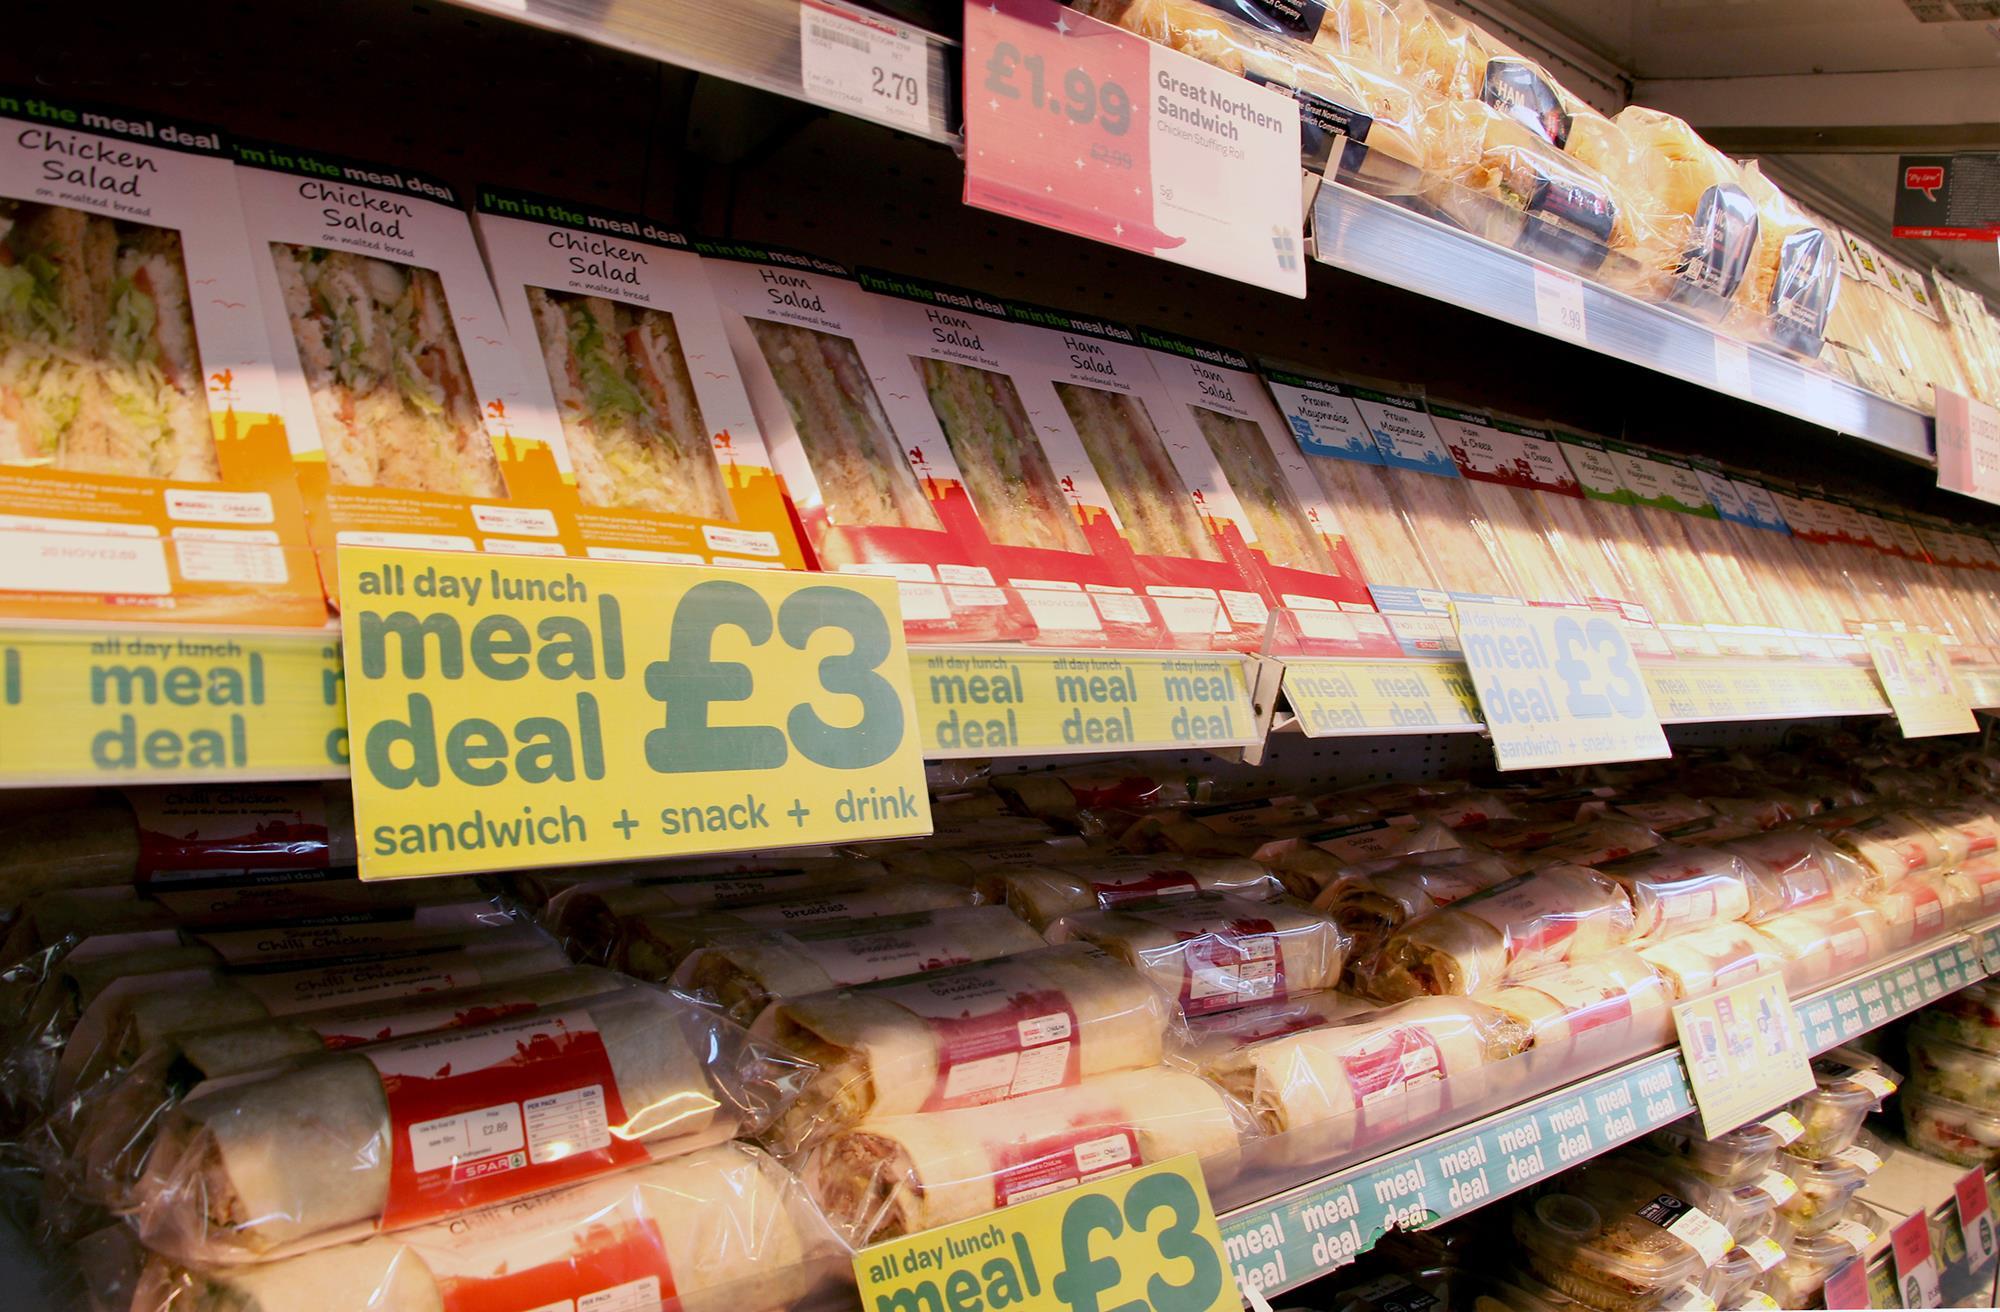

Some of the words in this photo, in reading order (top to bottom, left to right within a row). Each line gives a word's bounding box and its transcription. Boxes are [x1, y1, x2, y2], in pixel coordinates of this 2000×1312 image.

[1274, 0, 1302, 20] Company
[871, 66, 918, 106] 2.79
[984, 41, 1130, 136] £1.99
[1498, 80, 1525, 107] HAM
[1158, 70, 1207, 105] Great
[1210, 89, 1283, 134] Northern
[1305, 103, 1322, 116] Great
[1322, 107, 1348, 125] Northern
[25, 100, 77, 123] the
[82, 113, 155, 138] meal
[159, 126, 221, 150] deal
[1157, 95, 1239, 141] Sandwich
[1318, 119, 1346, 136] Company
[18, 129, 158, 173] Chicken
[1157, 119, 1193, 141] Chicken
[1193, 132, 1229, 157] Stuffing
[1229, 146, 1245, 160] Roll
[1090, 142, 1133, 169] £2.99
[42, 160, 141, 197] Salad
[270, 149, 293, 170] in
[298, 156, 340, 177] the
[344, 167, 402, 188] meal
[407, 176, 455, 201] deal
[36, 187, 54, 197] on
[60, 191, 109, 209] malted
[114, 200, 152, 217] bread
[299, 181, 412, 218] Chicken
[322, 209, 405, 240] Salad
[483, 193, 519, 213] I'm
[523, 199, 544, 218] in
[547, 206, 584, 225] the
[588, 214, 640, 237] meal
[643, 225, 688, 246] deal
[322, 233, 337, 243] on
[341, 237, 381, 250] malted
[384, 242, 415, 258] bread
[549, 231, 648, 265] Chicken
[569, 256, 641, 286] Salad
[768, 251, 812, 268] meal
[812, 257, 848, 276] deal
[568, 279, 582, 288] on
[585, 282, 620, 296] malted
[623, 288, 650, 302] bread
[758, 268, 812, 291] Ham
[768, 288, 826, 313] Salad
[906, 282, 934, 300] the
[934, 290, 973, 309] meal
[974, 297, 1006, 316] deal
[924, 308, 973, 331] Ham
[1070, 319, 1105, 335] meal
[1104, 325, 1134, 341] deal
[1561, 306, 1581, 330] 2.99
[932, 327, 985, 352] Salad
[1062, 335, 1105, 356] Ham
[1070, 354, 1117, 376] Salad
[1190, 362, 1225, 384] Ham
[1198, 380, 1236, 403] Salad
[1301, 393, 1334, 409] Prawn
[359, 563, 403, 596] all
[413, 565, 483, 606] day
[491, 568, 587, 603] lunch
[1474, 611, 1494, 629] day
[1495, 612, 1527, 629] lunch
[91, 638, 121, 657] all
[127, 639, 170, 660] day
[177, 639, 242, 658] lunch
[928, 657, 947, 669] all
[950, 657, 970, 671] day
[972, 657, 1008, 670] lunch
[90, 651, 266, 706] meal
[358, 592, 626, 681] meal
[644, 579, 905, 774] £3
[1053, 658, 1067, 671] all
[1069, 659, 1090, 673] day
[1091, 658, 1122, 671] lunch
[1161, 660, 1173, 671] all
[1175, 660, 1193, 673] day
[1194, 660, 1221, 672] lunch
[1463, 624, 1549, 669] meal
[1554, 615, 1646, 720] £3
[929, 665, 1024, 704] meal
[1055, 666, 1138, 703] meal
[1163, 665, 1235, 702] meal
[1295, 671, 1358, 698] meal
[1371, 670, 1431, 698] meal
[1655, 678, 1690, 695] meal
[1311, 701, 1367, 728] deal
[1389, 700, 1438, 727] deal
[1485, 674, 1560, 725] deal
[1669, 696, 1697, 717] deal
[936, 708, 1018, 749] deal
[1062, 707, 1135, 745] deal
[1170, 706, 1234, 741] deal
[91, 713, 248, 770] deal
[365, 691, 606, 790] deal
[1500, 733, 1562, 758] sandwich
[1583, 731, 1615, 752] snack
[373, 804, 587, 857] sandwich
[612, 808, 640, 841] +
[661, 793, 769, 836] snack
[786, 798, 811, 829] +
[834, 786, 919, 824] drink
[781, 904, 848, 919] Breakfast
[257, 939, 304, 951] Chilli
[312, 935, 384, 949] Chicken
[294, 976, 345, 992] Chilli
[1860, 980, 1882, 1004] meal
[1808, 1000, 1833, 1026] meal
[1835, 990, 1859, 1015] meal
[1868, 1000, 1888, 1024] deal
[1815, 1022, 1838, 1047] deal
[1842, 1011, 1863, 1035] deal
[1638, 1064, 1674, 1097] meal
[527, 1101, 540, 1110] PER
[541, 1099, 557, 1107] PACK
[1594, 1080, 1632, 1115] meal
[1646, 1090, 1677, 1122] deal
[482, 1121, 509, 1136] £2.89
[1549, 1096, 1589, 1134] meal
[1604, 1107, 1637, 1142] deal
[1498, 1115, 1542, 1155] meal
[1558, 1125, 1593, 1161] deal
[466, 1158, 509, 1177] SPAR
[1440, 1135, 1488, 1178] meal
[1506, 1145, 1545, 1184] deal
[1374, 1159, 1427, 1204] meal
[1448, 1168, 1491, 1209] deal
[1301, 1184, 1360, 1233] meal
[1384, 1192, 1429, 1234] deal
[875, 1231, 1042, 1312] meal
[1053, 1172, 1223, 1312] £3
[1223, 1212, 1286, 1264] meal
[1312, 1220, 1362, 1266] deal
[869, 1253, 899, 1284] all
[904, 1241, 944, 1274] day
[947, 1224, 1006, 1261] lunch
[1233, 1249, 1287, 1300] deal
